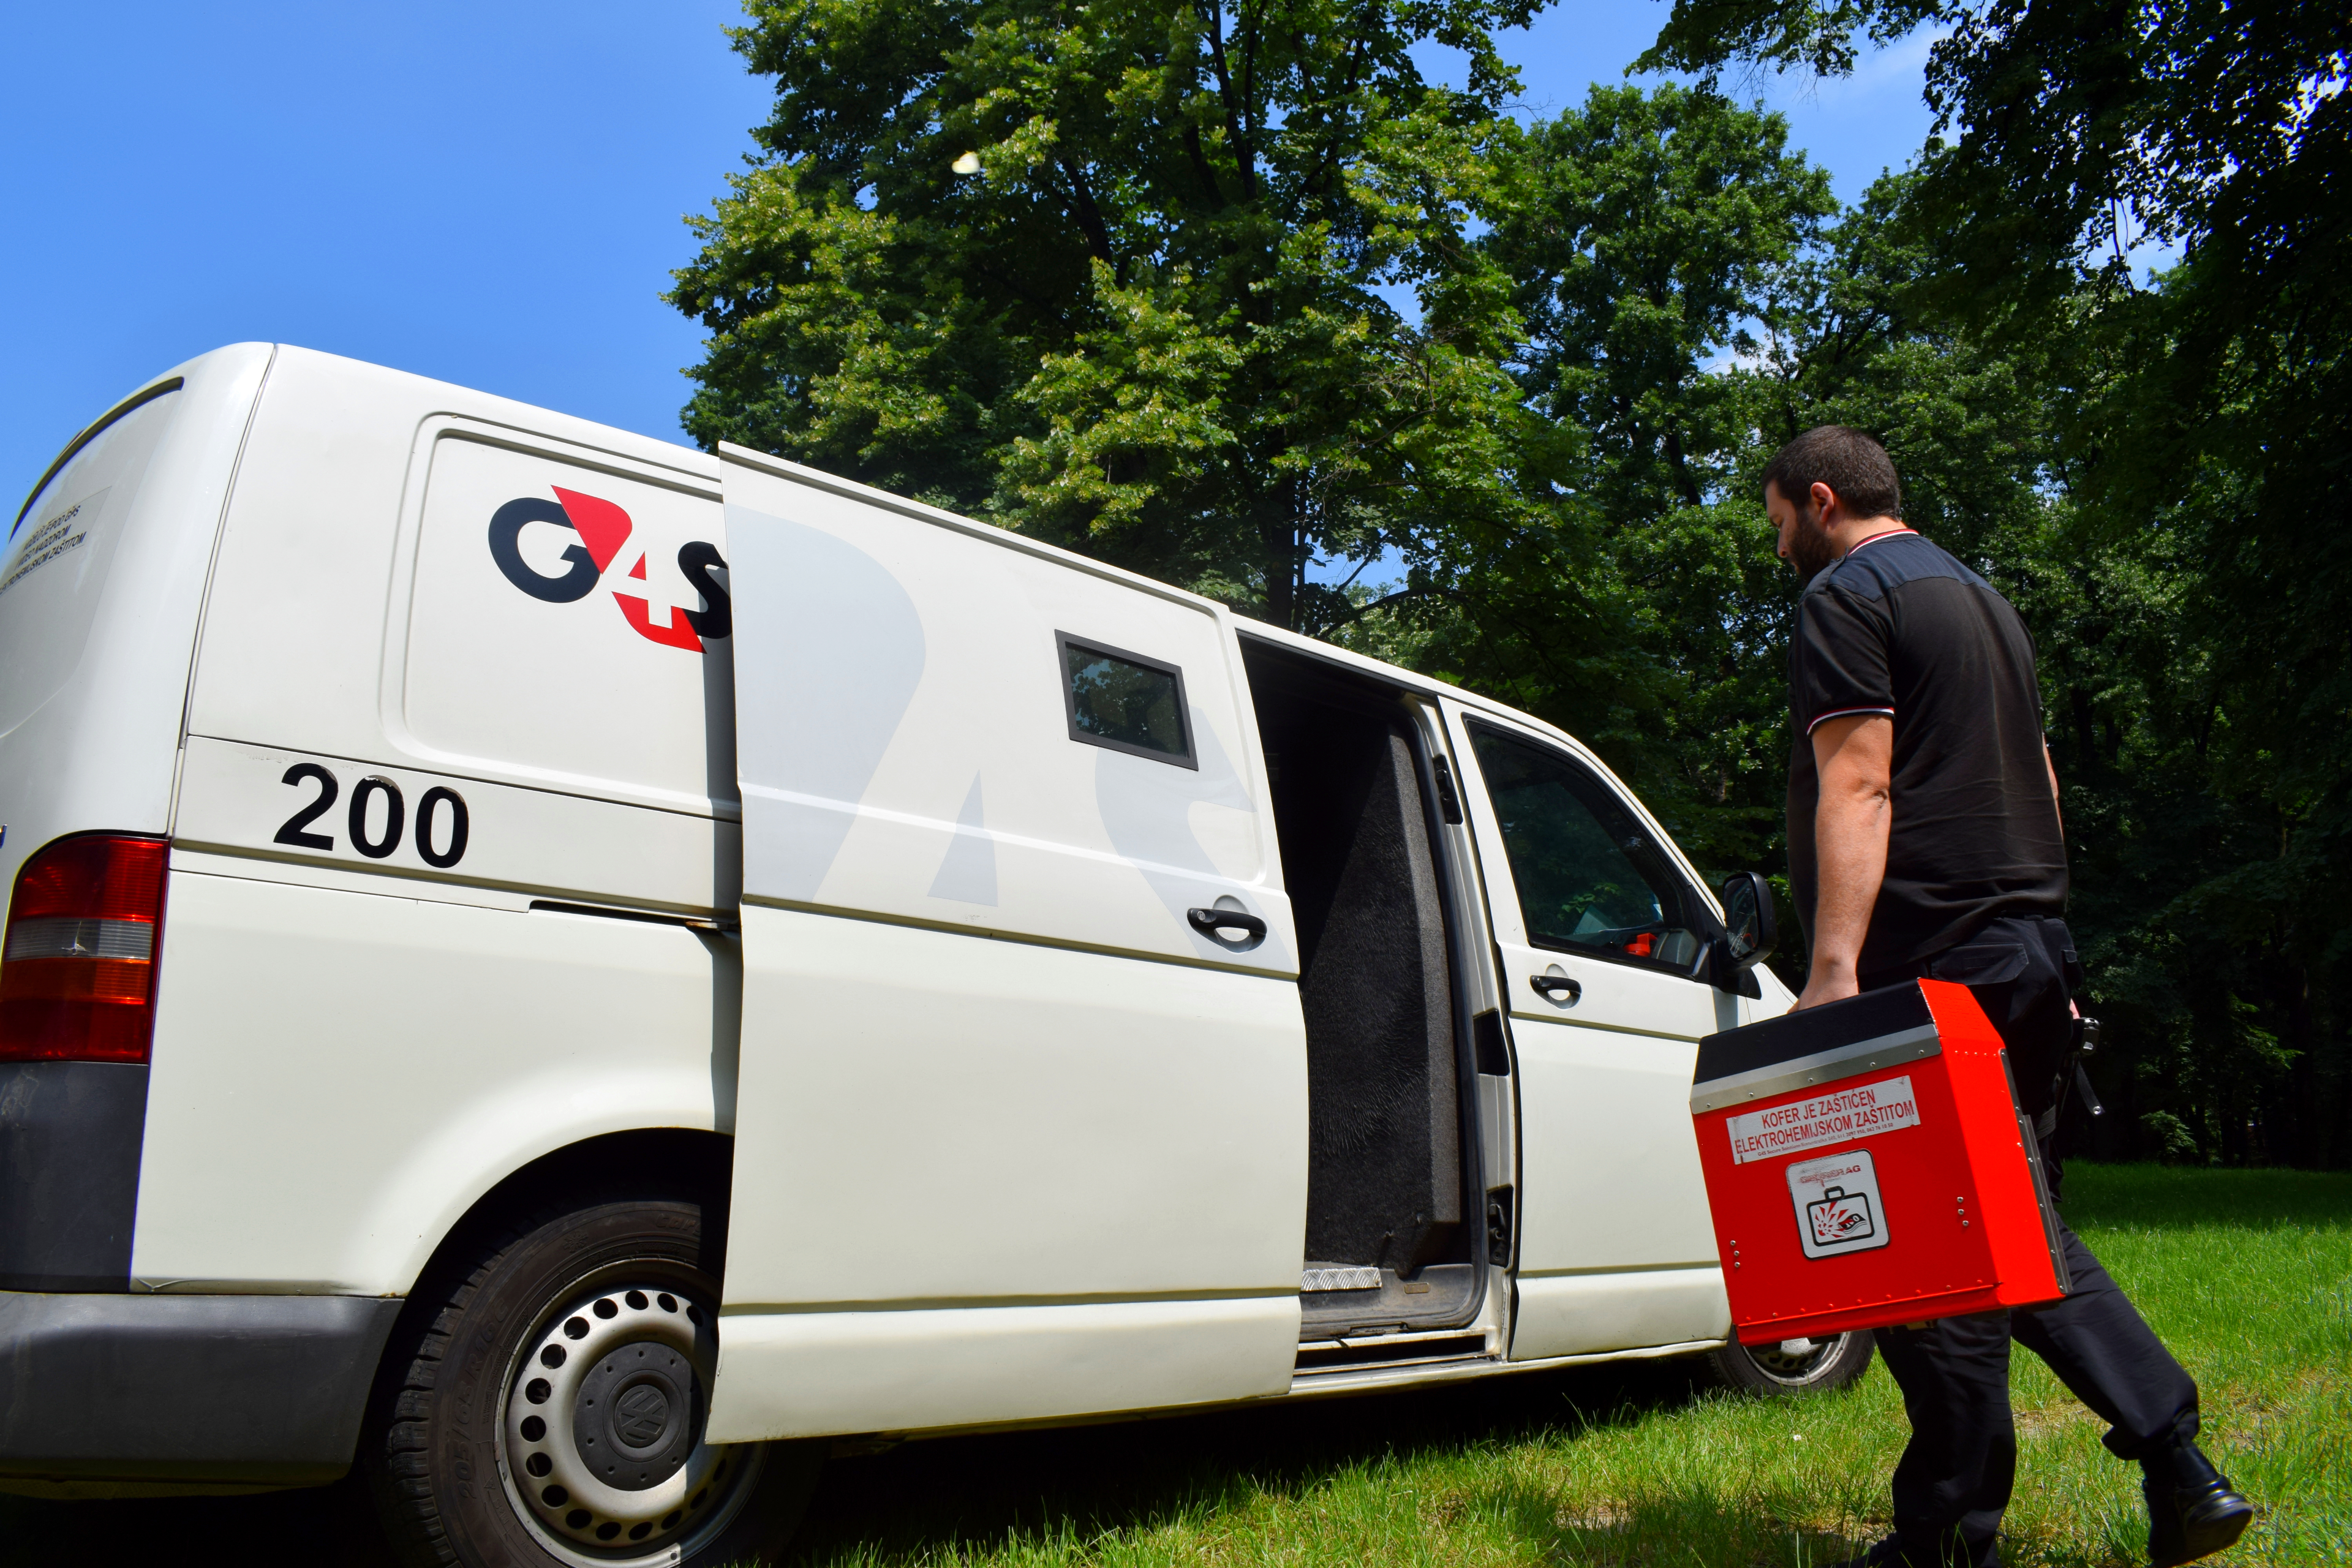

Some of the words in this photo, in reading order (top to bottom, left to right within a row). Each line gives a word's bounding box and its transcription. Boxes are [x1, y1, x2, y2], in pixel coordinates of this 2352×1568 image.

[48, 531, 87, 560] ZAŠTITOM
[488, 484, 733, 654] G4S
[273, 763, 469, 869] 200
[1735, 1114, 1853, 1154] ELEKTROHEMIJSKOM
[1856, 1100, 1915, 1128] ZAŠTITOM
[1762, 1107, 1801, 1129] KOFER
[1803, 1103, 1817, 1120] JE
[1819, 1089, 1876, 1115] ZAŠTIĆEN
